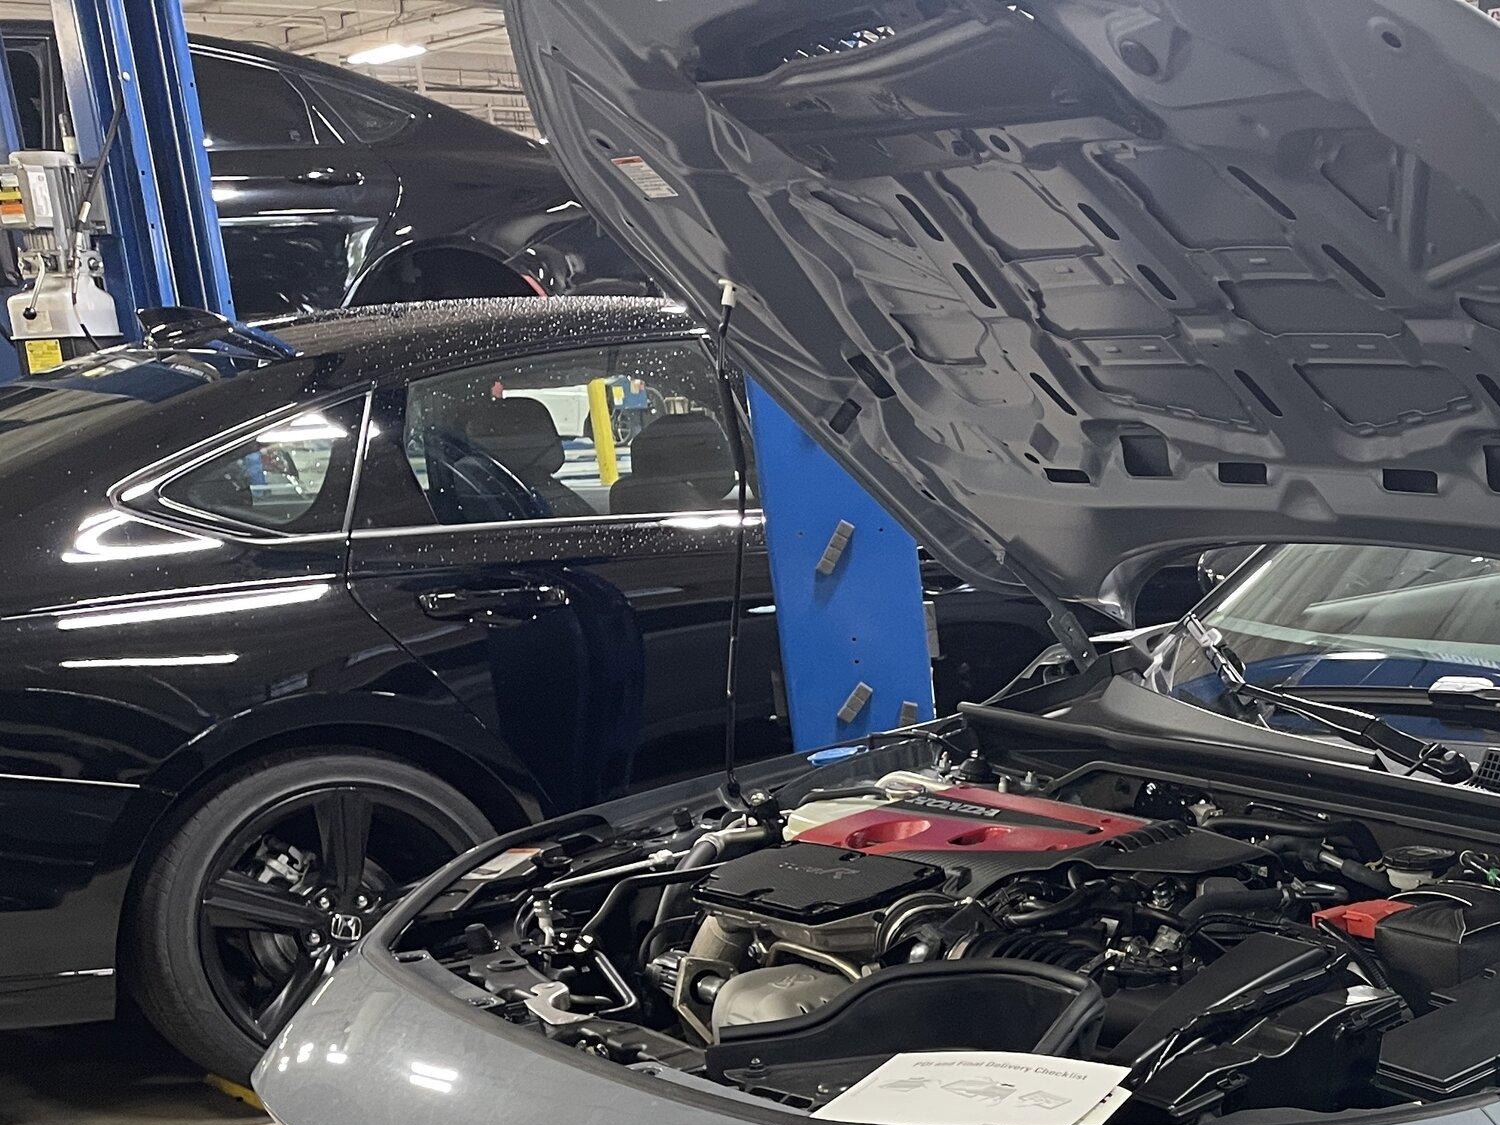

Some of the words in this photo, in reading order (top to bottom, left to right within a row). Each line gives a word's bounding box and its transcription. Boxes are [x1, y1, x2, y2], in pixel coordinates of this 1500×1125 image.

[905, 796, 1001, 818] HONDA
[985, 1061, 1032, 1073] Delivery
[1034, 1066, 1088, 1081] Checklist
